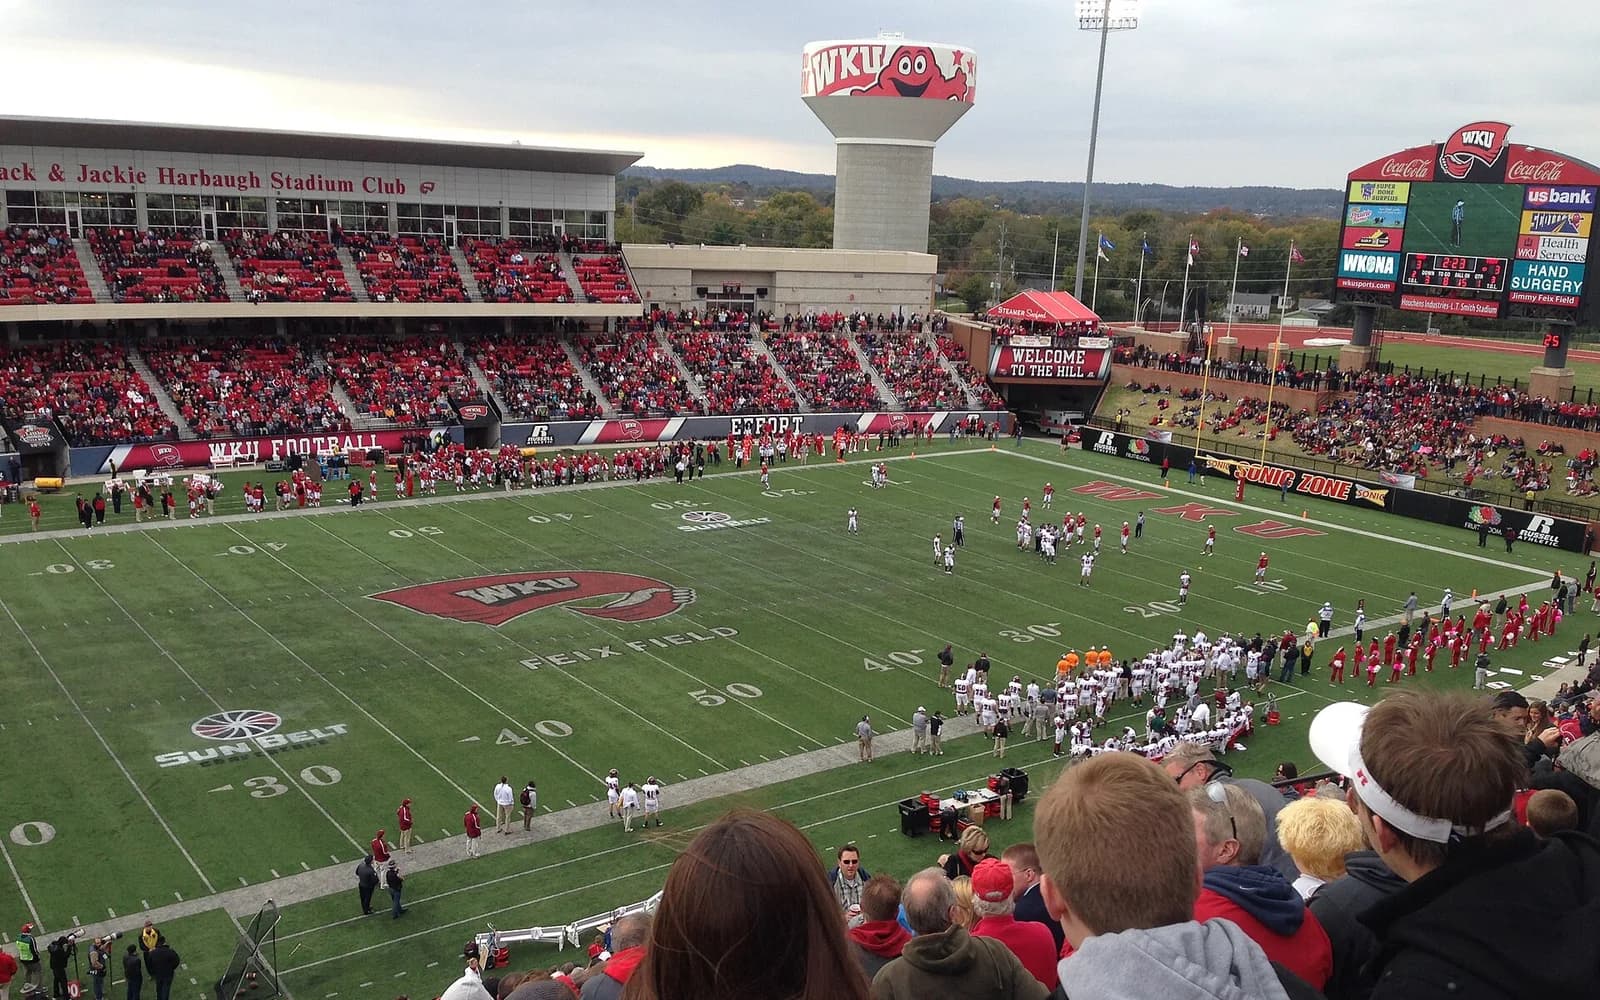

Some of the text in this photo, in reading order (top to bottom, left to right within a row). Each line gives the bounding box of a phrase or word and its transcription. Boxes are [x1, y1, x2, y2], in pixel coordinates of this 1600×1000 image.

[812, 46, 884, 91] WKU
[1462, 130, 1495, 148] WKU
[1381, 158, 1432, 178] Coca-Cola
[1508, 160, 1567, 180] Coca-Cola
[49, 163, 65, 182] &
[77, 164, 146, 184] Jackie
[157, 167, 260, 191] Harbaugh
[271, 172, 354, 192] Stadium
[362, 176, 406, 195] Club
[1540, 237, 1579, 249] Health
[1442, 257, 1466, 269] 2:23
[1518, 248, 1586, 261] WKU Services
[1528, 264, 1569, 278] HAND
[1342, 280, 1391, 289] wkusports.com
[1511, 277, 1583, 293] SURGERY
[1401, 297, 1424, 306] Houchens
[1460, 303, 1476, 312] Smith
[1476, 304, 1498, 314] Stadium
[1511, 292, 1575, 304] Jimmy Feix Field
[998, 306, 1025, 316] STEAMER
[1544, 334, 1559, 347] 25
[1013, 348, 1086, 364] WELCOME
[1011, 364, 1084, 377] TO THE HILL
[208, 434, 382, 461] WKU FOOTBALL
[1094, 442, 1118, 452] RUSSELL
[1207, 460, 1229, 470] SONIC
[1234, 462, 1353, 501] SONIC ZONE
[1356, 488, 1385, 500] SONIC
[1517, 535, 1560, 547] ATHLETIC
[1519, 529, 1560, 543] RUSSELL
[454, 576, 580, 605] WKU
[1123, 601, 1181, 618] 20
[999, 623, 1062, 643] 30
[519, 626, 740, 671] FEIX FIELD
[863, 650, 924, 673] 40
[687, 682, 763, 707] 50
[495, 719, 573, 747] 40
[154, 741, 252, 768] SUN
[255, 723, 348, 750] BELT
[243, 764, 343, 798] 30
